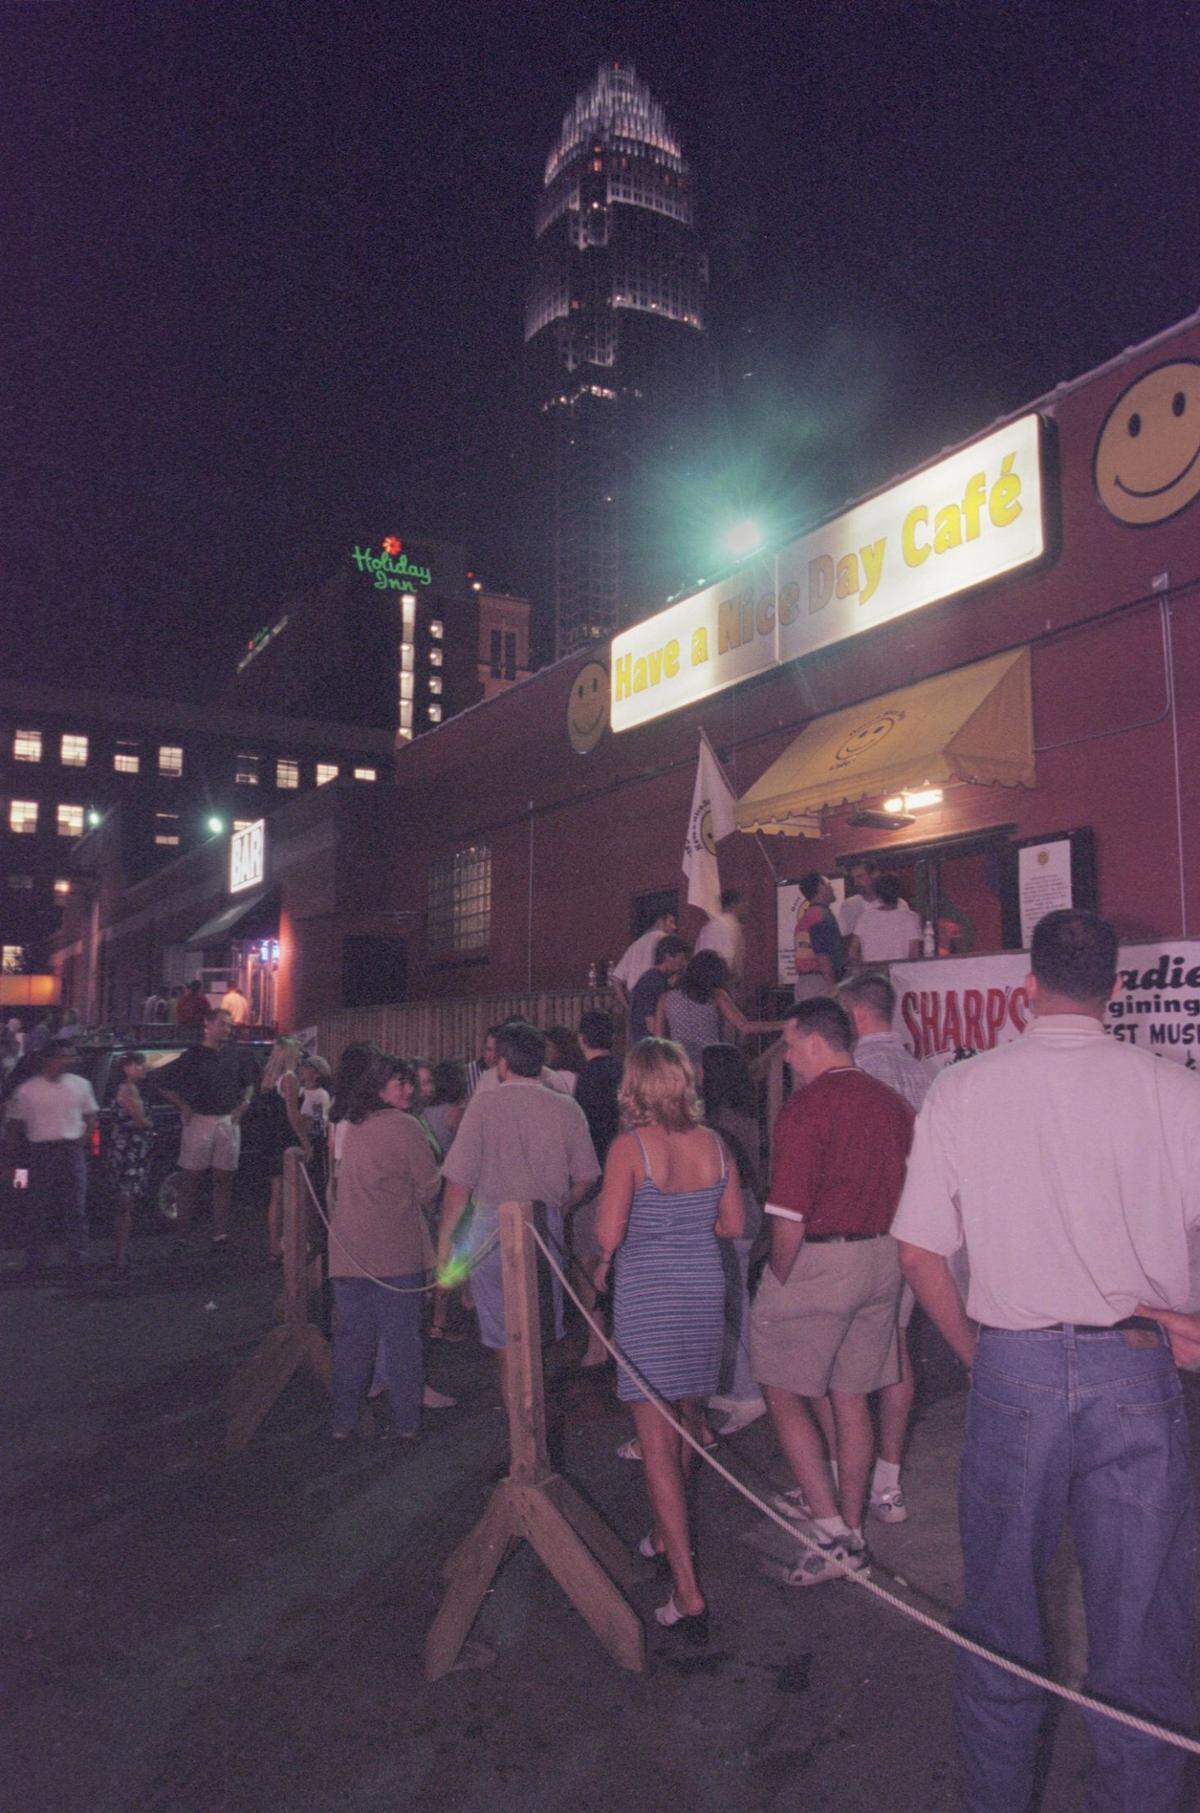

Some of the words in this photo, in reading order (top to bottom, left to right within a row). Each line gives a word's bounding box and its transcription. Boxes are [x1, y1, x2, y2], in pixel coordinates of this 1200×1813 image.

[352, 545, 432, 585] Holiday
[374, 570, 418, 593] Inn
[614, 638, 681, 702] Have
[691, 626, 709, 667] a
[717, 581, 800, 656] Nice
[807, 536, 887, 606] Day
[901, 450, 1024, 569] Café
